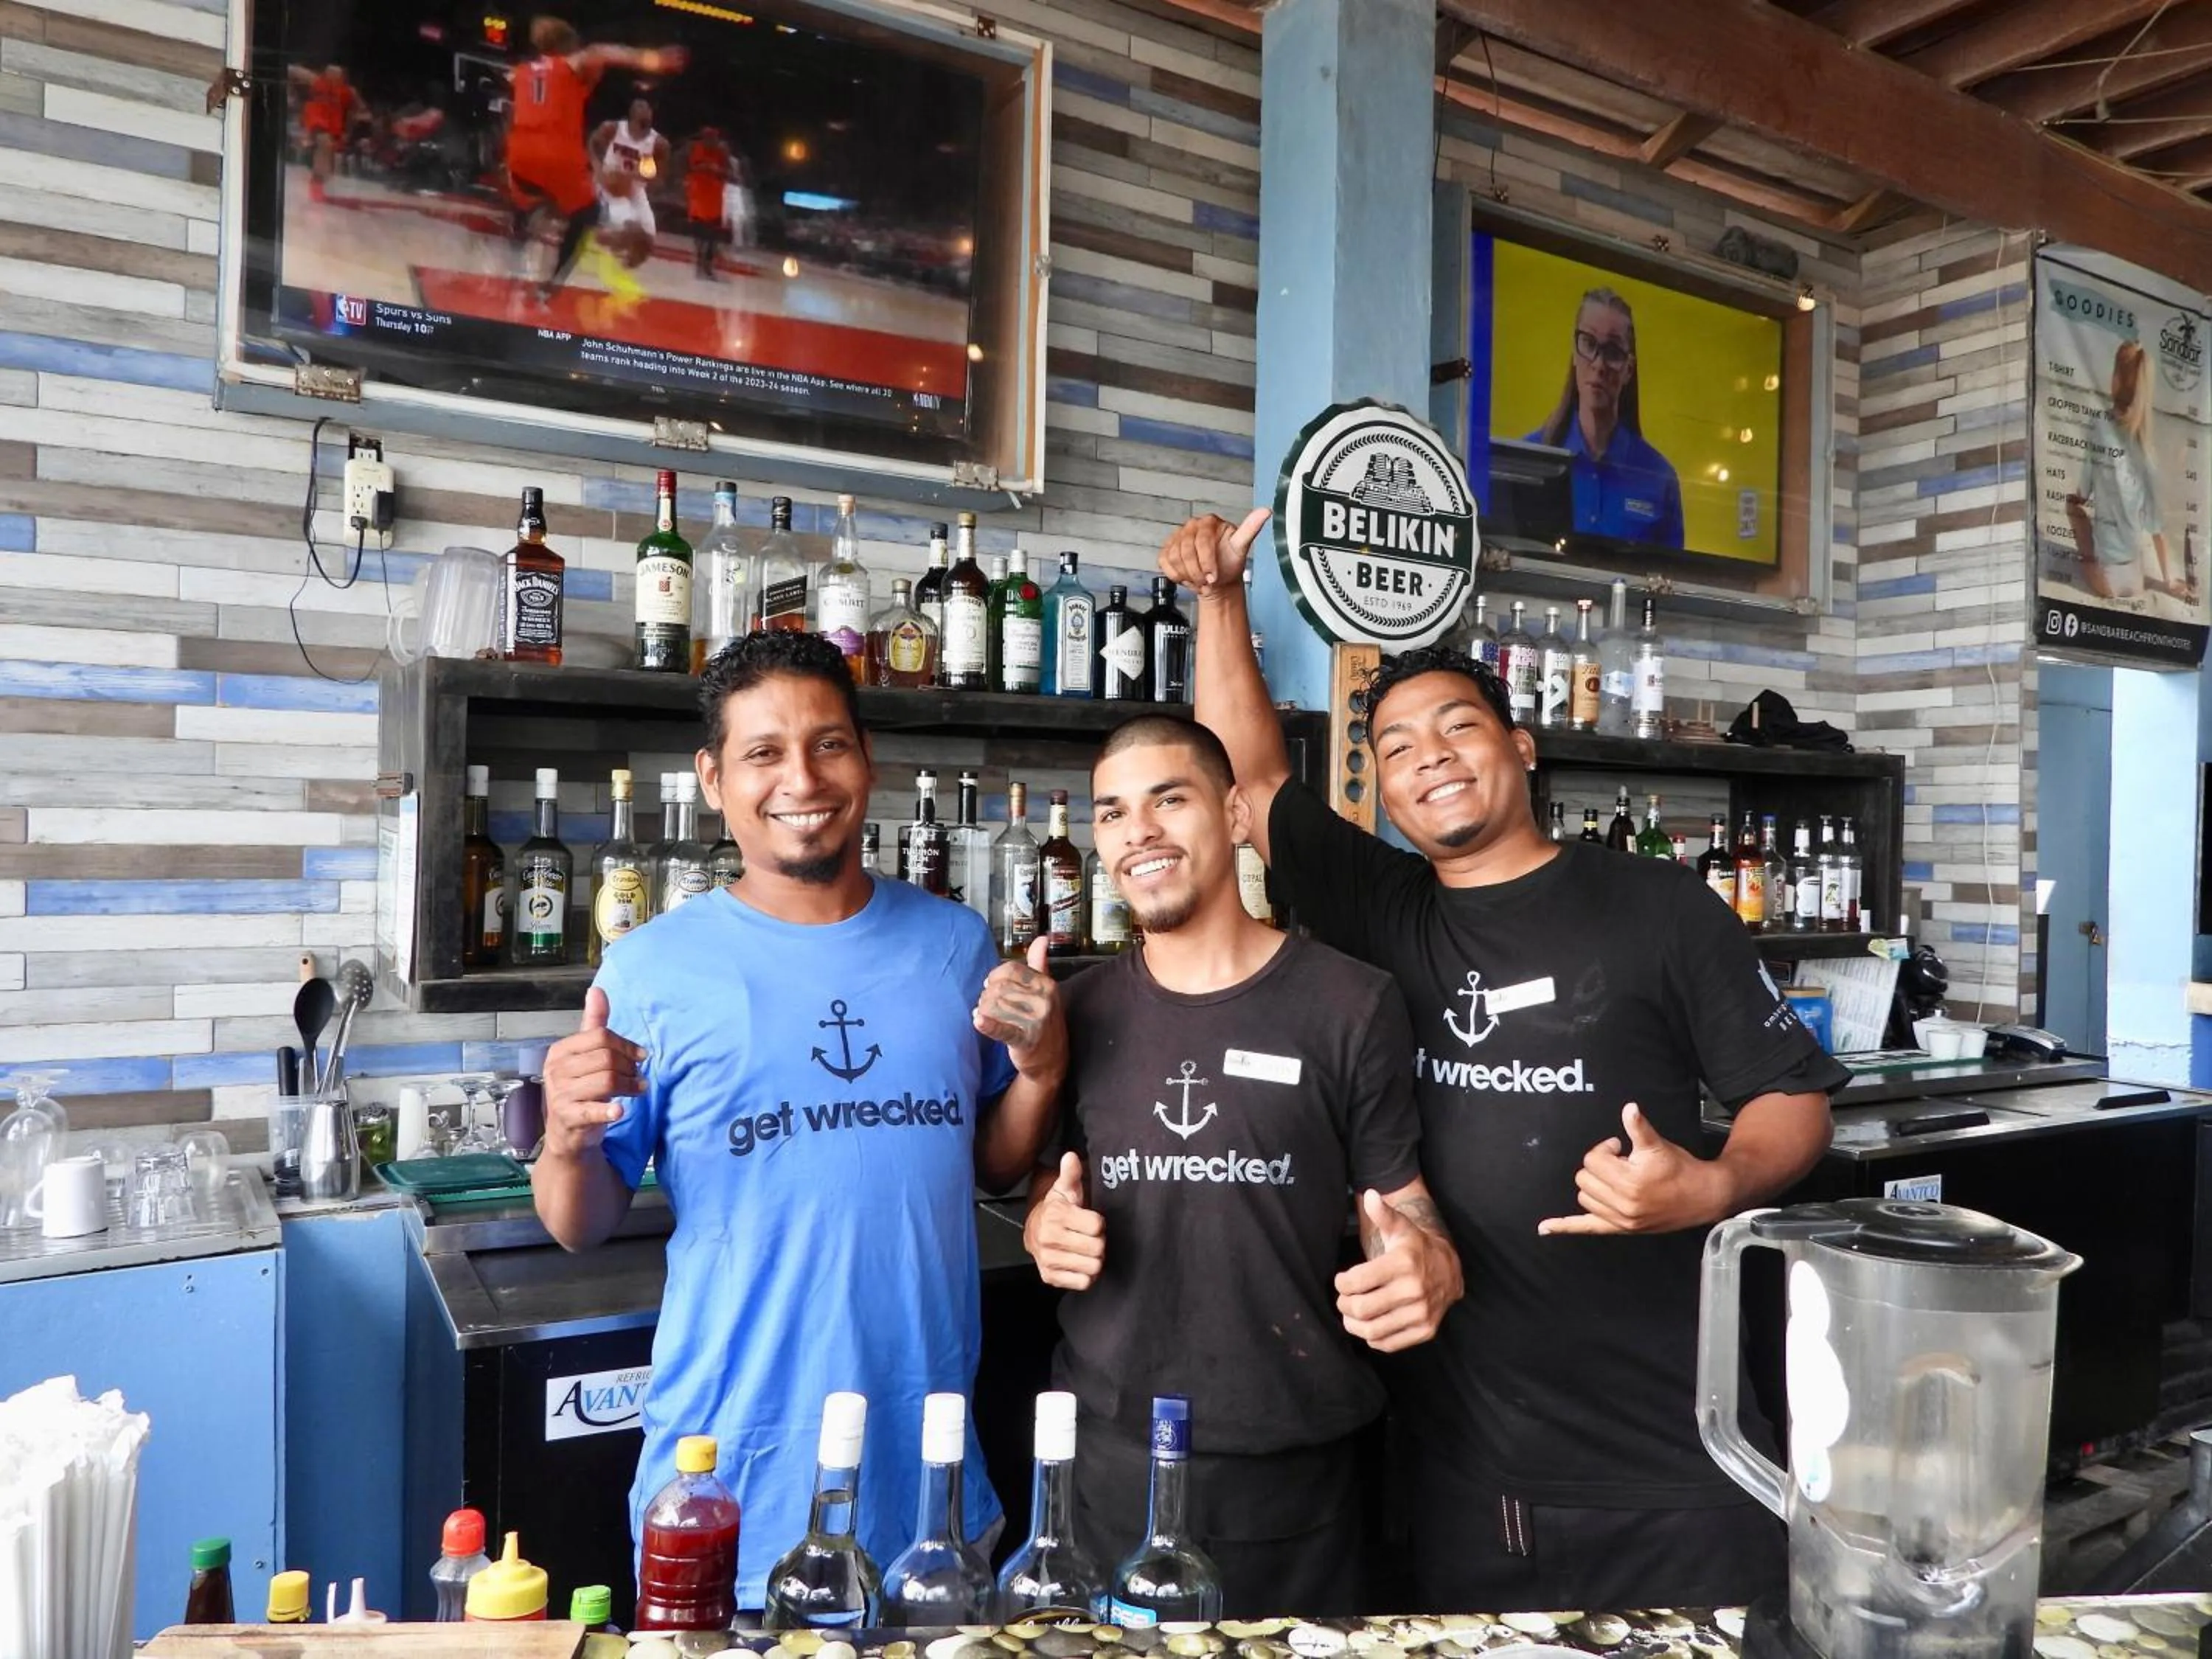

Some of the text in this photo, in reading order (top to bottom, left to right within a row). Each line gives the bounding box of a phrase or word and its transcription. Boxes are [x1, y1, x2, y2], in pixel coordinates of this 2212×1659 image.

[349, 302, 364, 319] TV
[376, 303, 452, 324] Spurs vs Suns
[2054, 290, 2135, 328] GOODIES
[375, 317, 411, 333] Thursday
[538, 329, 571, 341] NBA APP
[581, 338, 604, 349] John
[605, 341, 664, 360] Schuhmann's
[666, 352, 693, 364] Power
[695, 357, 734, 372] Rankings
[735, 365, 750, 374] are
[751, 366, 766, 377] live
[768, 369, 775, 378] in
[776, 370, 790, 380] the
[791, 374, 809, 384] NBA
[830, 380, 844, 390] See
[846, 383, 869, 394] where
[871, 386, 881, 396] all
[581, 350, 810, 396] teams rank heading into Week 2 of the 2023-24 season.
[2081, 405, 2102, 419] TANK
[2108, 447, 2124, 458] TOP
[2046, 467, 2065, 479] HATS
[1323, 501, 1455, 558] BELIKIN
[639, 563, 690, 579] JAMESON
[1356, 561, 1423, 597] BEER
[785, 589, 804, 599] LABEL
[1363, 595, 1412, 611] ESTD 1969
[1432, 1058, 1594, 1093] wrecked.
[729, 1092, 964, 1157] get wrecked.
[1102, 1148, 1295, 1190] get wrecked.
